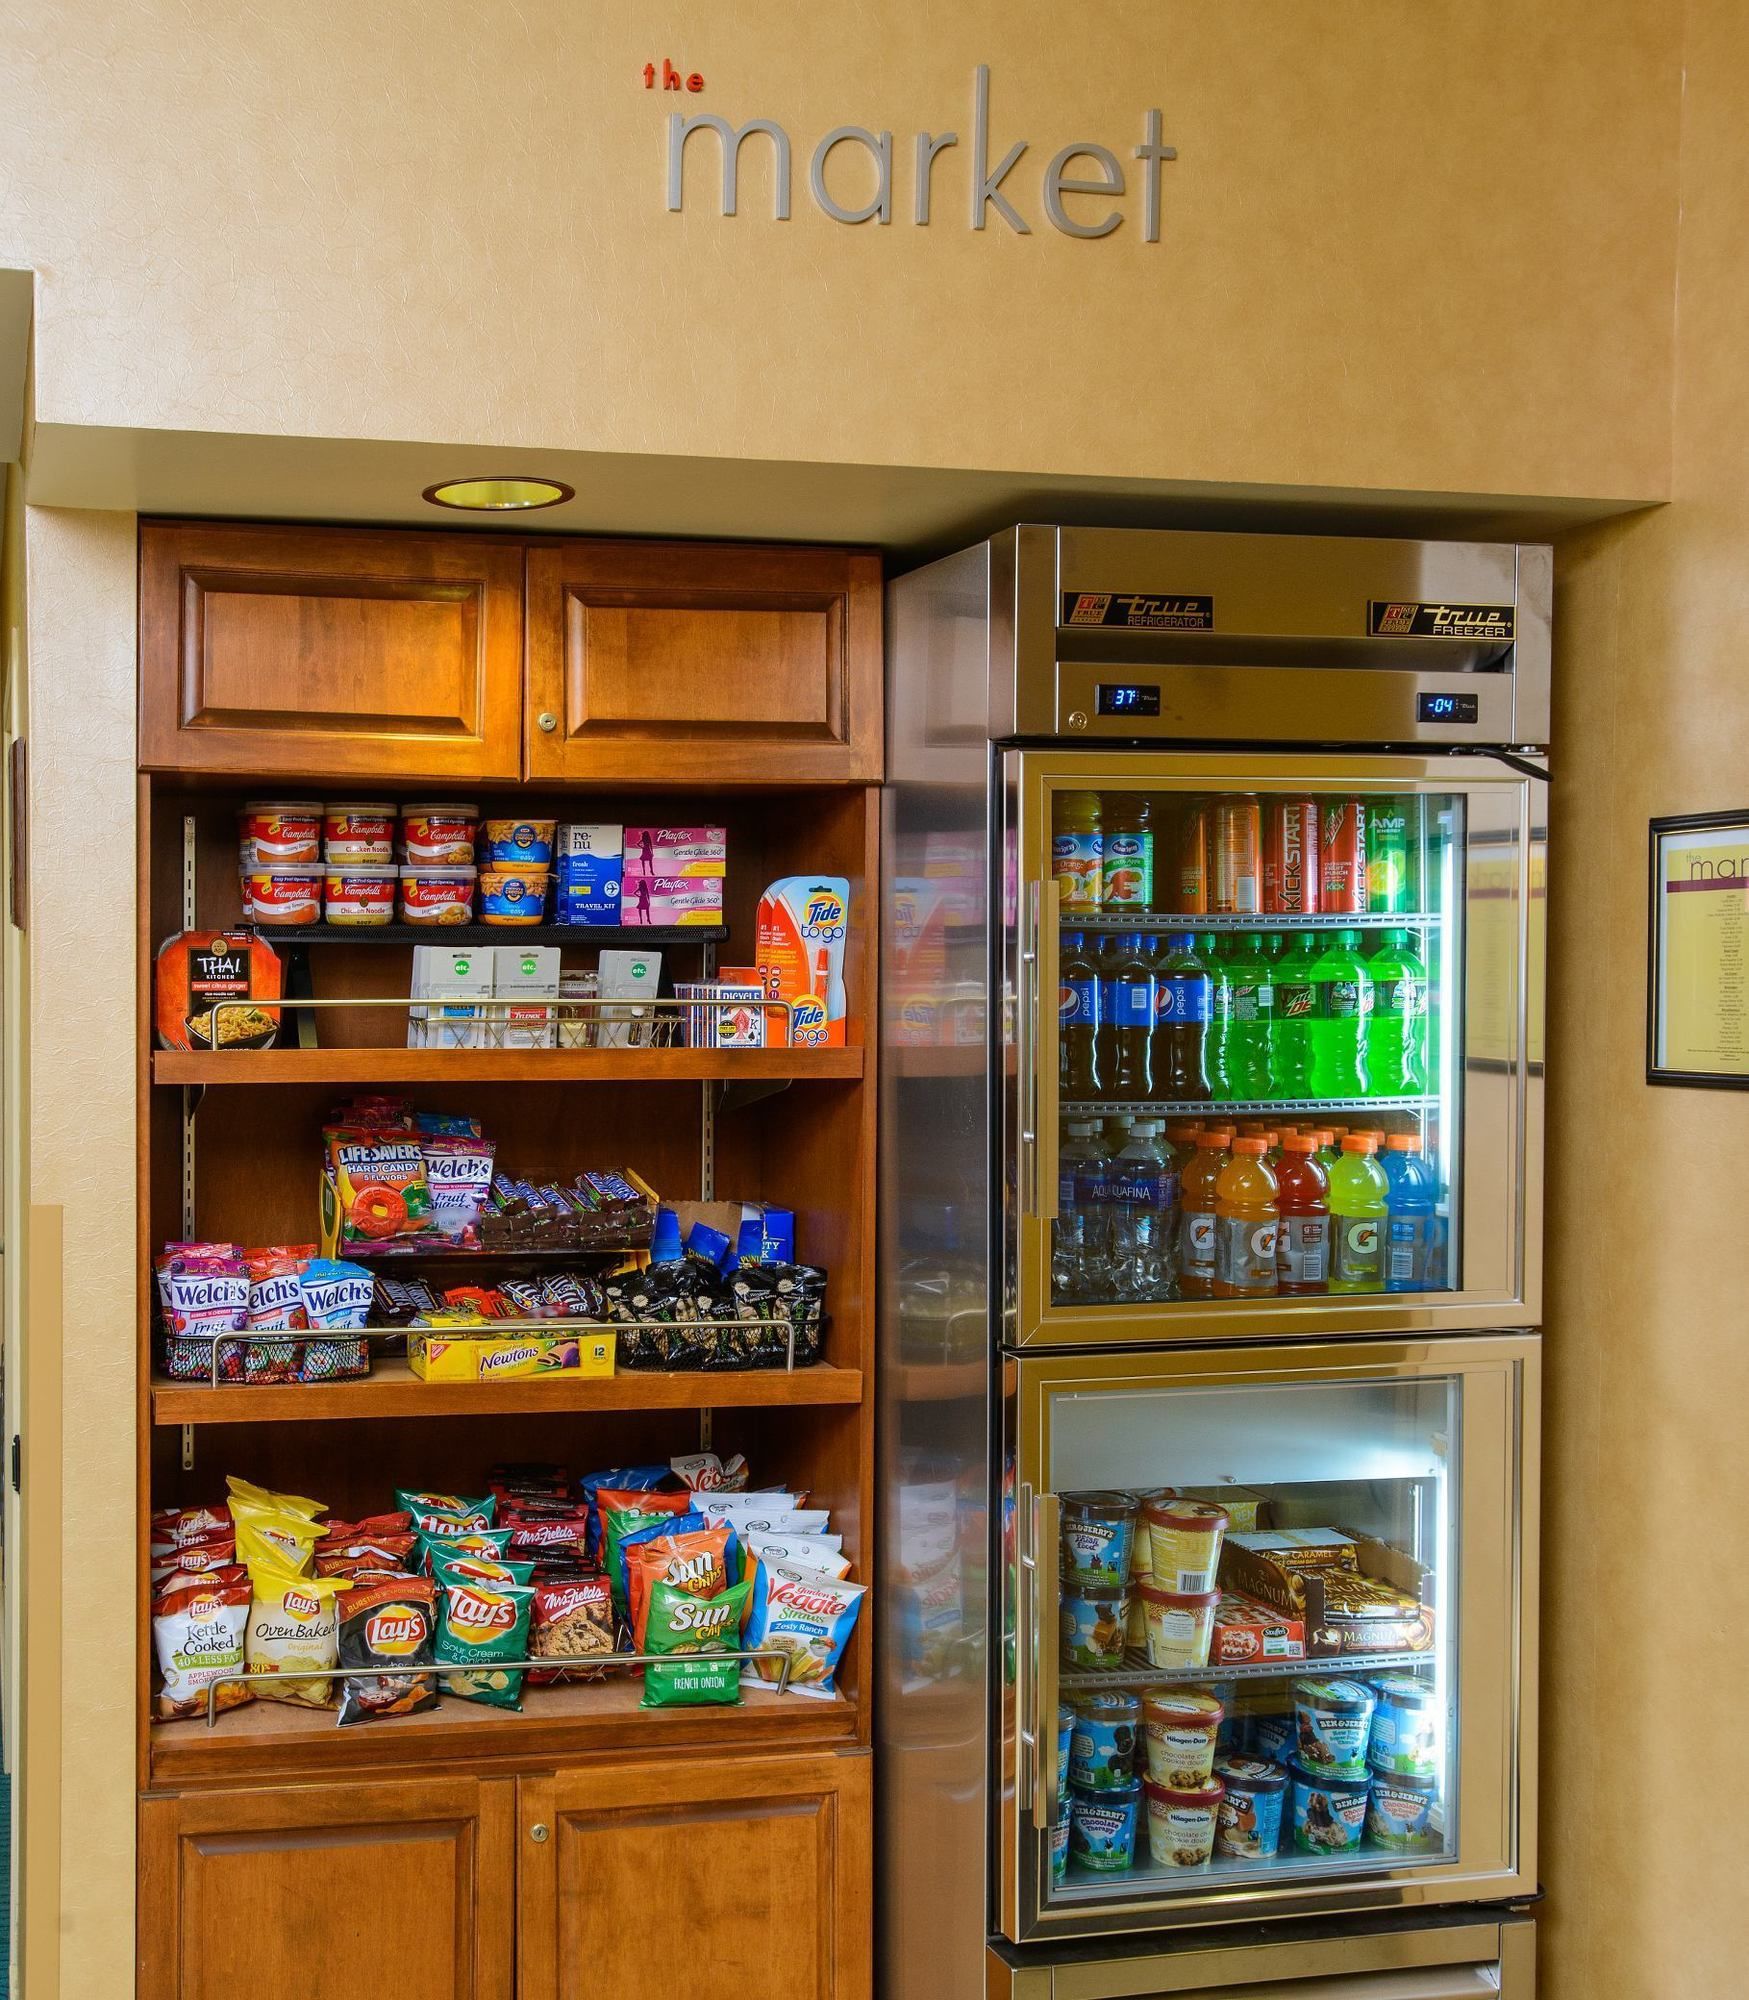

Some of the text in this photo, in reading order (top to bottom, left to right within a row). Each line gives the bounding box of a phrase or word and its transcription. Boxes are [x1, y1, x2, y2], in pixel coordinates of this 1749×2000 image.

[642, 57, 704, 92] the
[666, 63, 1178, 243] market
[1116, 595, 1204, 617] true
[1127, 615, 1204, 627] REFRIGERATOR
[1423, 606, 1507, 627] true
[1433, 625, 1506, 637] FREEZER
[1427, 698, 1453, 713] -04
[1368, 817, 1406, 829] AMP
[657, 829, 692, 843] Playtex
[1280, 804, 1300, 912] KICKSTART
[1685, 853, 1702, 863] the
[653, 878, 689, 892] Playtex
[808, 902, 841, 925] Tide
[801, 925, 844, 944] to go
[197, 957, 241, 974] THAI
[455, 963, 470, 972] etc.
[521, 963, 537, 972] etc.
[632, 967, 647, 975] etc.
[1082, 987, 1091, 1017] pepsi
[1176, 986, 1186, 1016] pepsi
[514, 1011, 544, 1019] TYLENOL
[793, 1008, 824, 1028] Tide
[807, 1030, 828, 1047] go
[339, 1143, 423, 1164] LIFE SAVERS
[347, 1162, 419, 1174] HARD CANDY
[425, 1158, 490, 1181] Welch's
[371, 1173, 408, 1181] FLAVORS
[435, 1192, 468, 1204] Fruit
[1347, 1222, 1378, 1254] G
[249, 1281, 299, 1307] elch's
[305, 1282, 373, 1311] Welch's
[480, 1345, 540, 1372] Newtons
[593, 1346, 605, 1356] 12
[539, 1526, 576, 1542] Fields
[1292, 1551, 1333, 1559] CARAMEL
[663, 1551, 715, 1587] Sun
[686, 1565, 722, 1592] Chips
[564, 1585, 606, 1606] Fields
[767, 1577, 848, 1616] Veggie
[795, 1585, 830, 1602] garden
[1238, 1569, 1295, 1611] MAGNUM
[190, 1599, 222, 1617] Lay's
[284, 1592, 320, 1614] Lay's
[450, 1589, 515, 1627] Lay's
[668, 1603, 732, 1632] Sun
[778, 1607, 826, 1624] Straws
[186, 1620, 228, 1641] Kettle
[370, 1615, 422, 1644] Lay's
[774, 1621, 824, 1636] Zesty Ranch
[183, 1635, 235, 1656] Cooked
[287, 1642, 324, 1652] Original
[441, 1640, 504, 1659] Sour Cream
[178, 1652, 241, 1667] 40% LESS FAT
[451, 1652, 491, 1665] & Onion
[187, 1667, 235, 1680] APPLEWOOD
[674, 1676, 725, 1690] FRENCH ONION
[1096, 1808, 1126, 1821] JERRY'S
[1080, 1818, 1120, 1830] Chocolate
[1086, 1825, 1115, 1836] Therapy
